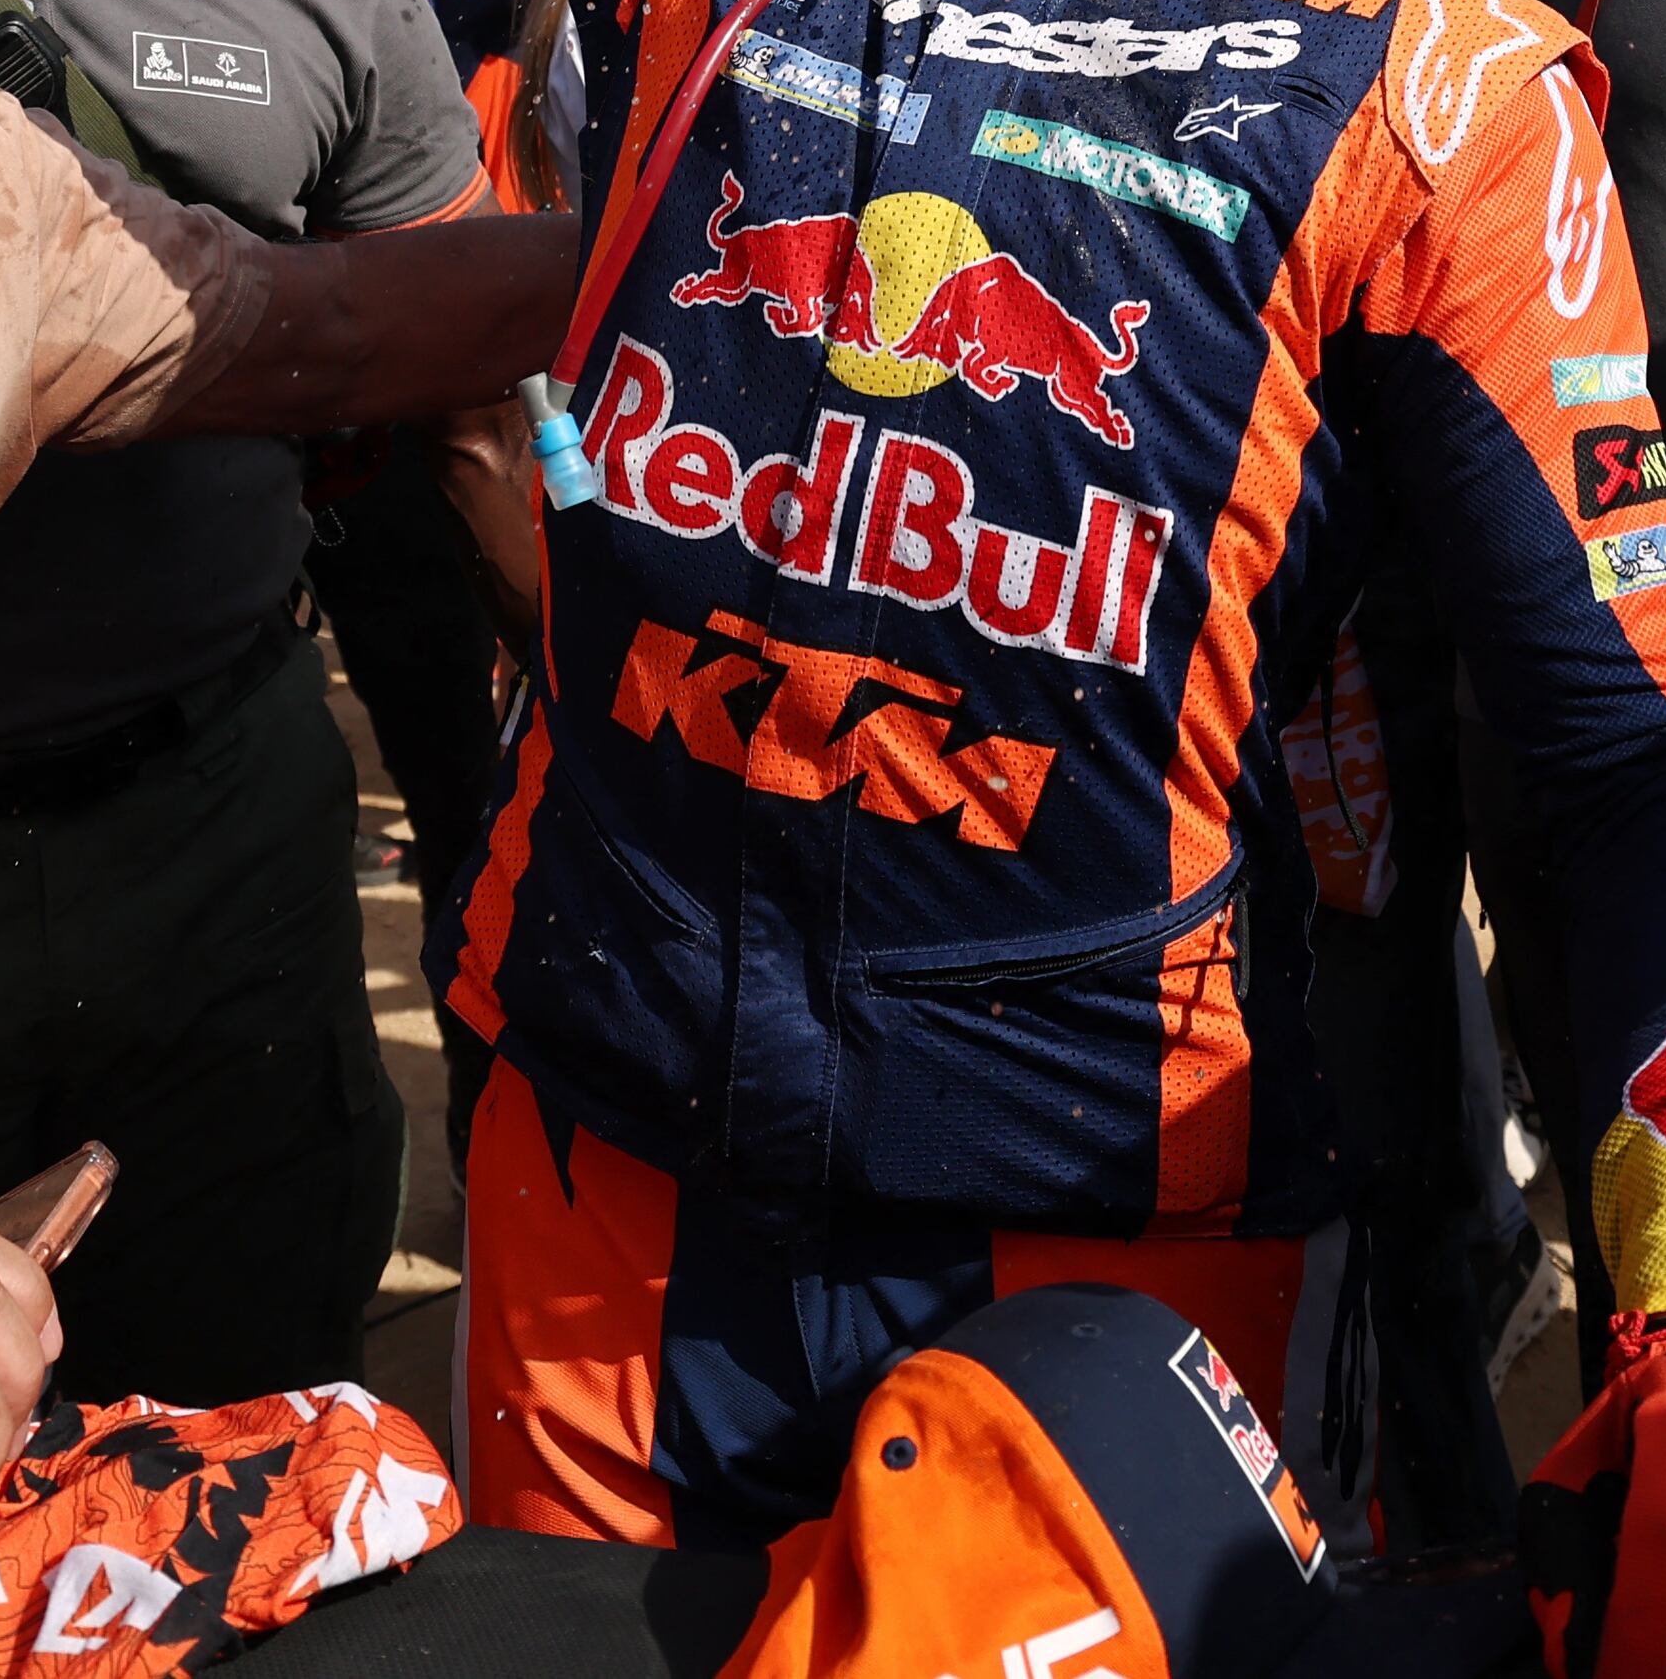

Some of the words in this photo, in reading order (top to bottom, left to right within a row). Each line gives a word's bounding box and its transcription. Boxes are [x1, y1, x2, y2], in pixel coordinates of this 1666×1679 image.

[142, 66, 176, 82] DAKAR
[191, 75, 223, 88] SAUDI
[225, 80, 263, 95] ARABIA
[1039, 129, 1235, 231] MOTOREX
[609, 608, 1058, 853] KTM
